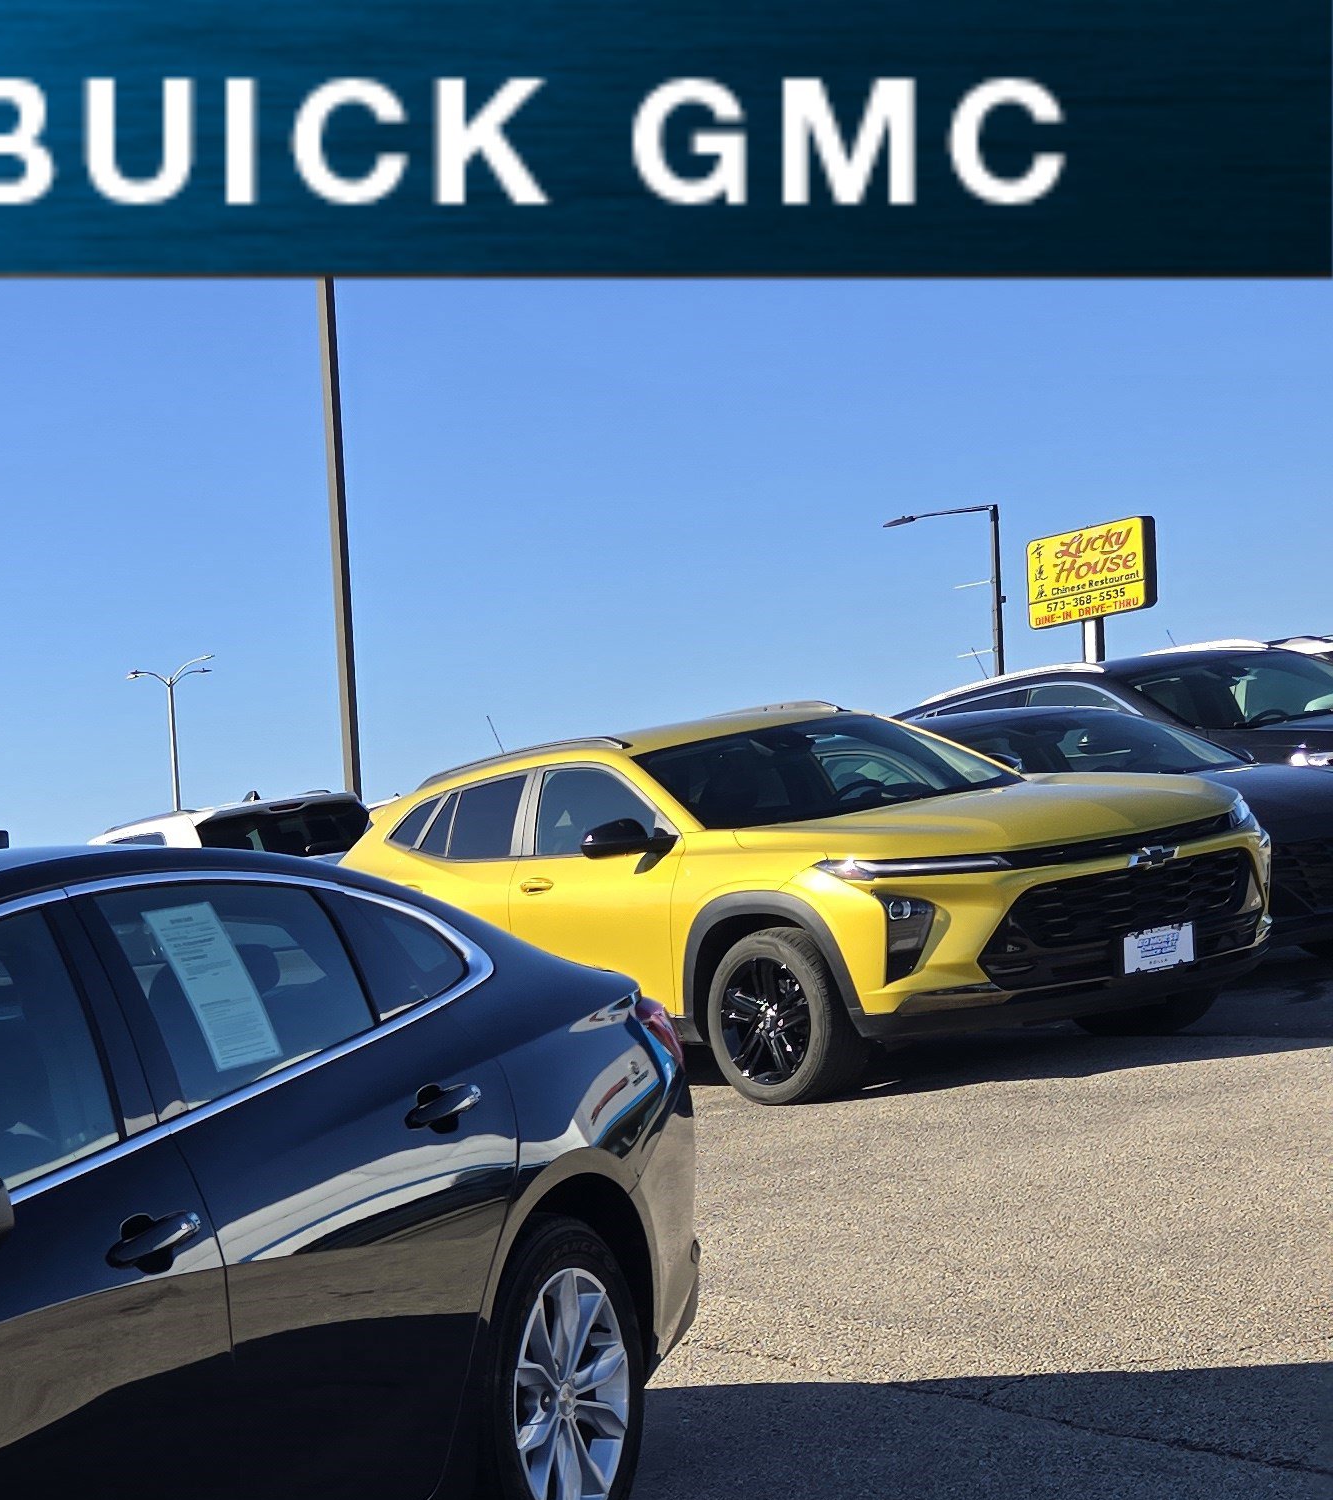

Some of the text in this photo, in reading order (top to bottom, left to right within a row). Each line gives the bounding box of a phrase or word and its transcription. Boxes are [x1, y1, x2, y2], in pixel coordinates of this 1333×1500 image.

[1055, 526, 1133, 559] Lucky
[1053, 551, 1137, 583] House
[1051, 569, 1140, 596] Chinese Restaurant
[1035, 597, 1139, 626] DINE-IN DRIVE-THRU
[1046, 587, 1126, 613] 573-368-5535
